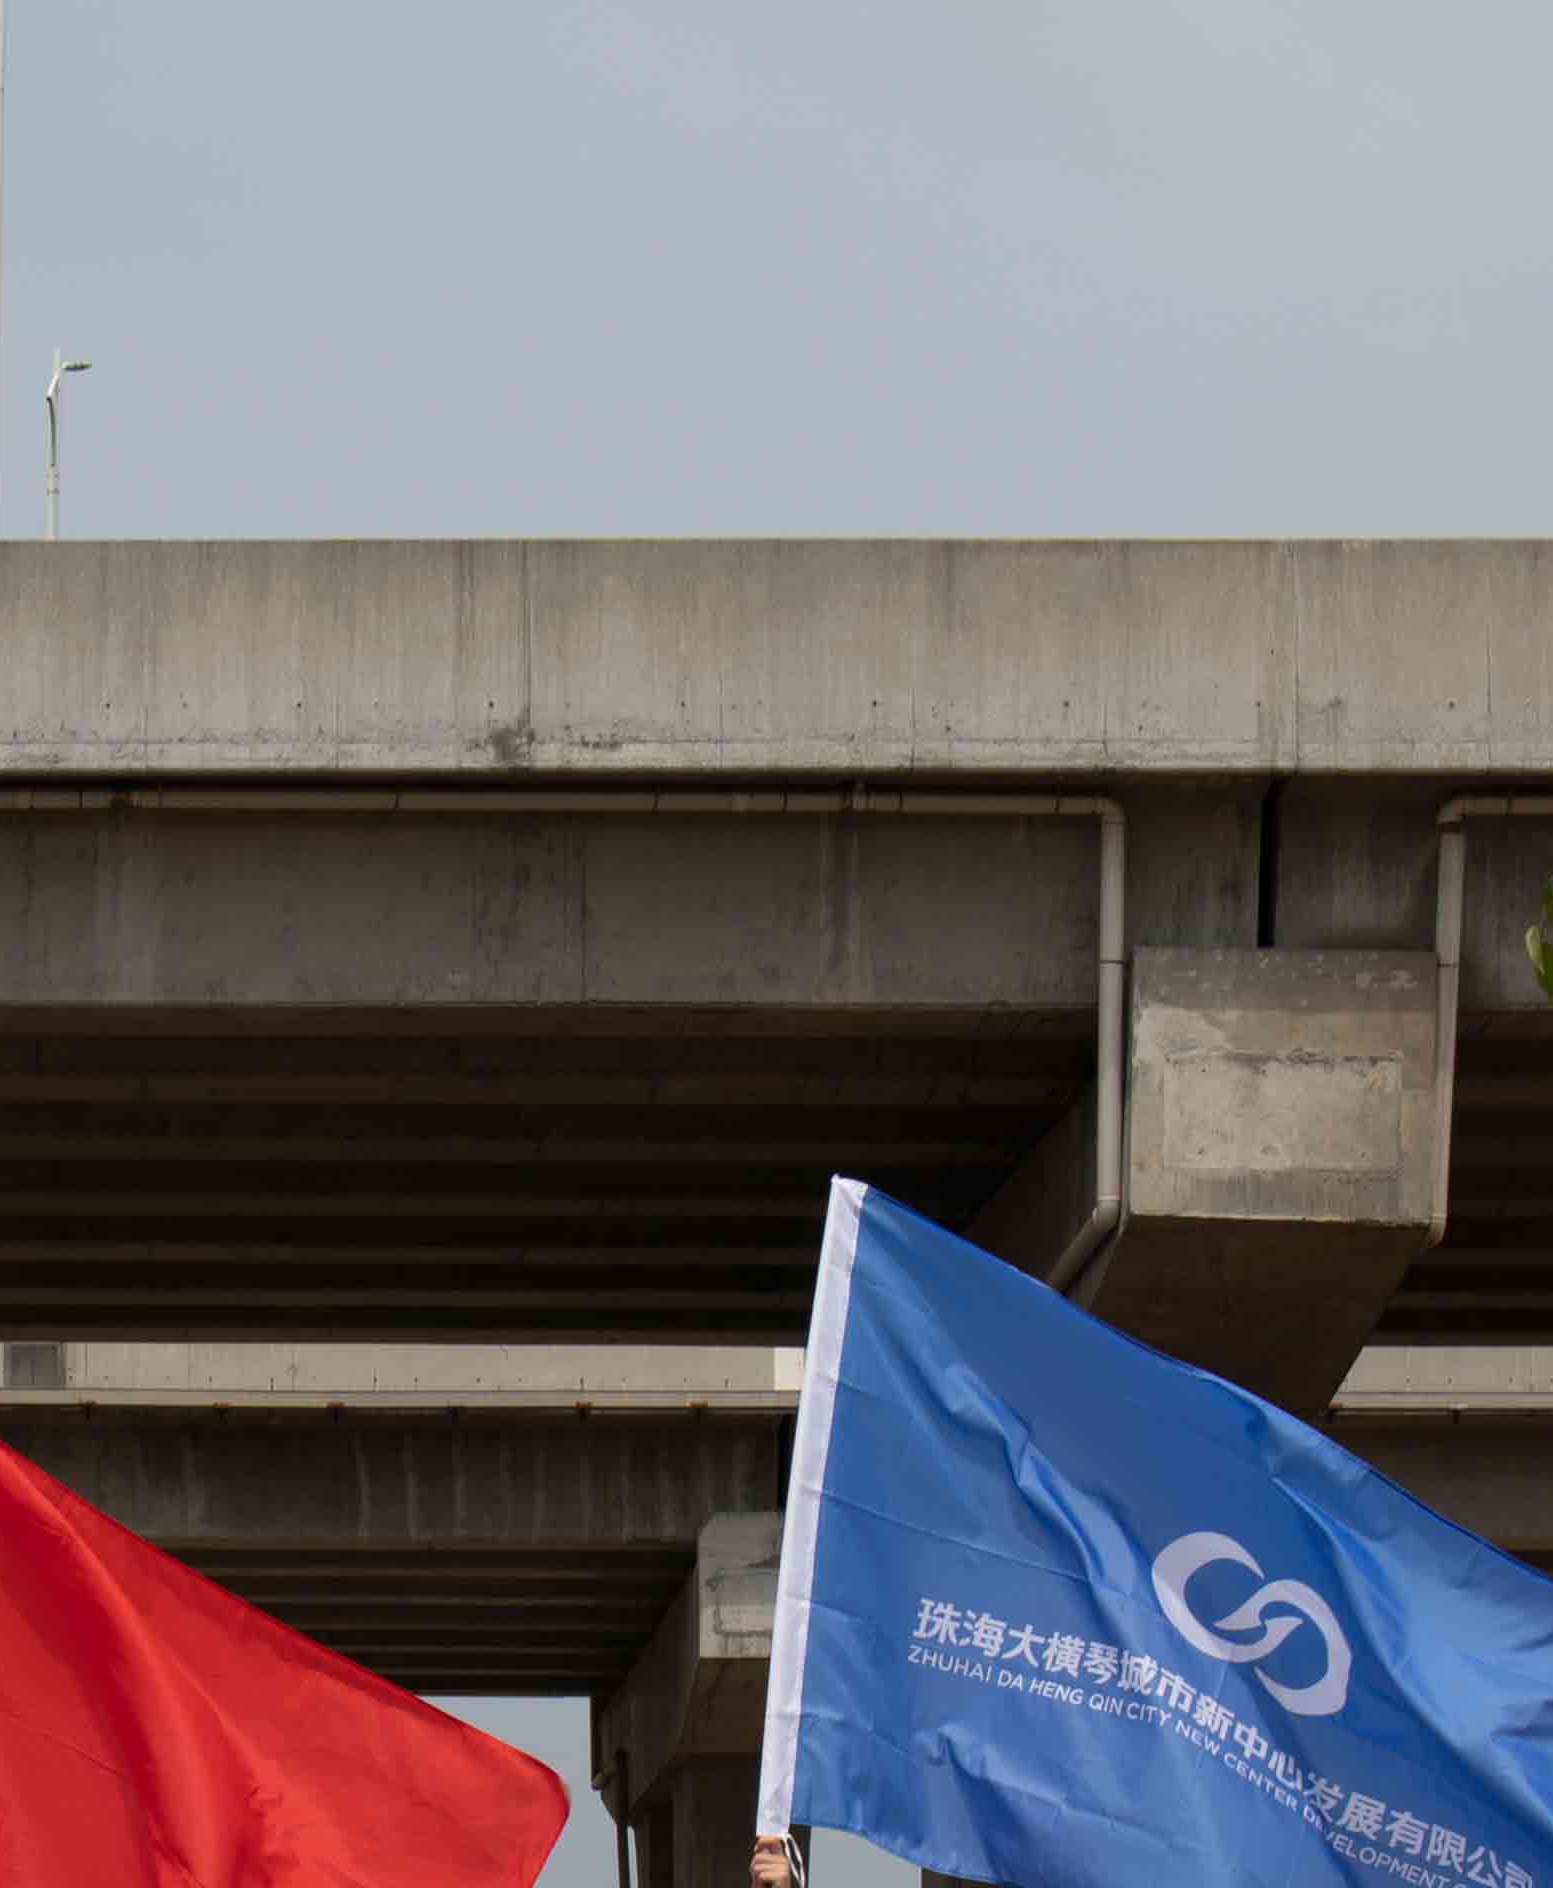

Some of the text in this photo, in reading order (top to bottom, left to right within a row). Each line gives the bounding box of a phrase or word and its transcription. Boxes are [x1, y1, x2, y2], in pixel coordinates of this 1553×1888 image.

[907, 1645, 992, 1682] ZHUHAI
[997, 1669, 1025, 1692] DA
[1028, 1679, 1085, 1706] HENG
[1089, 1693, 1125, 1717] QIN
[1126, 1701, 1173, 1727] CITY
[1174, 1721, 1221, 1757] NEW
